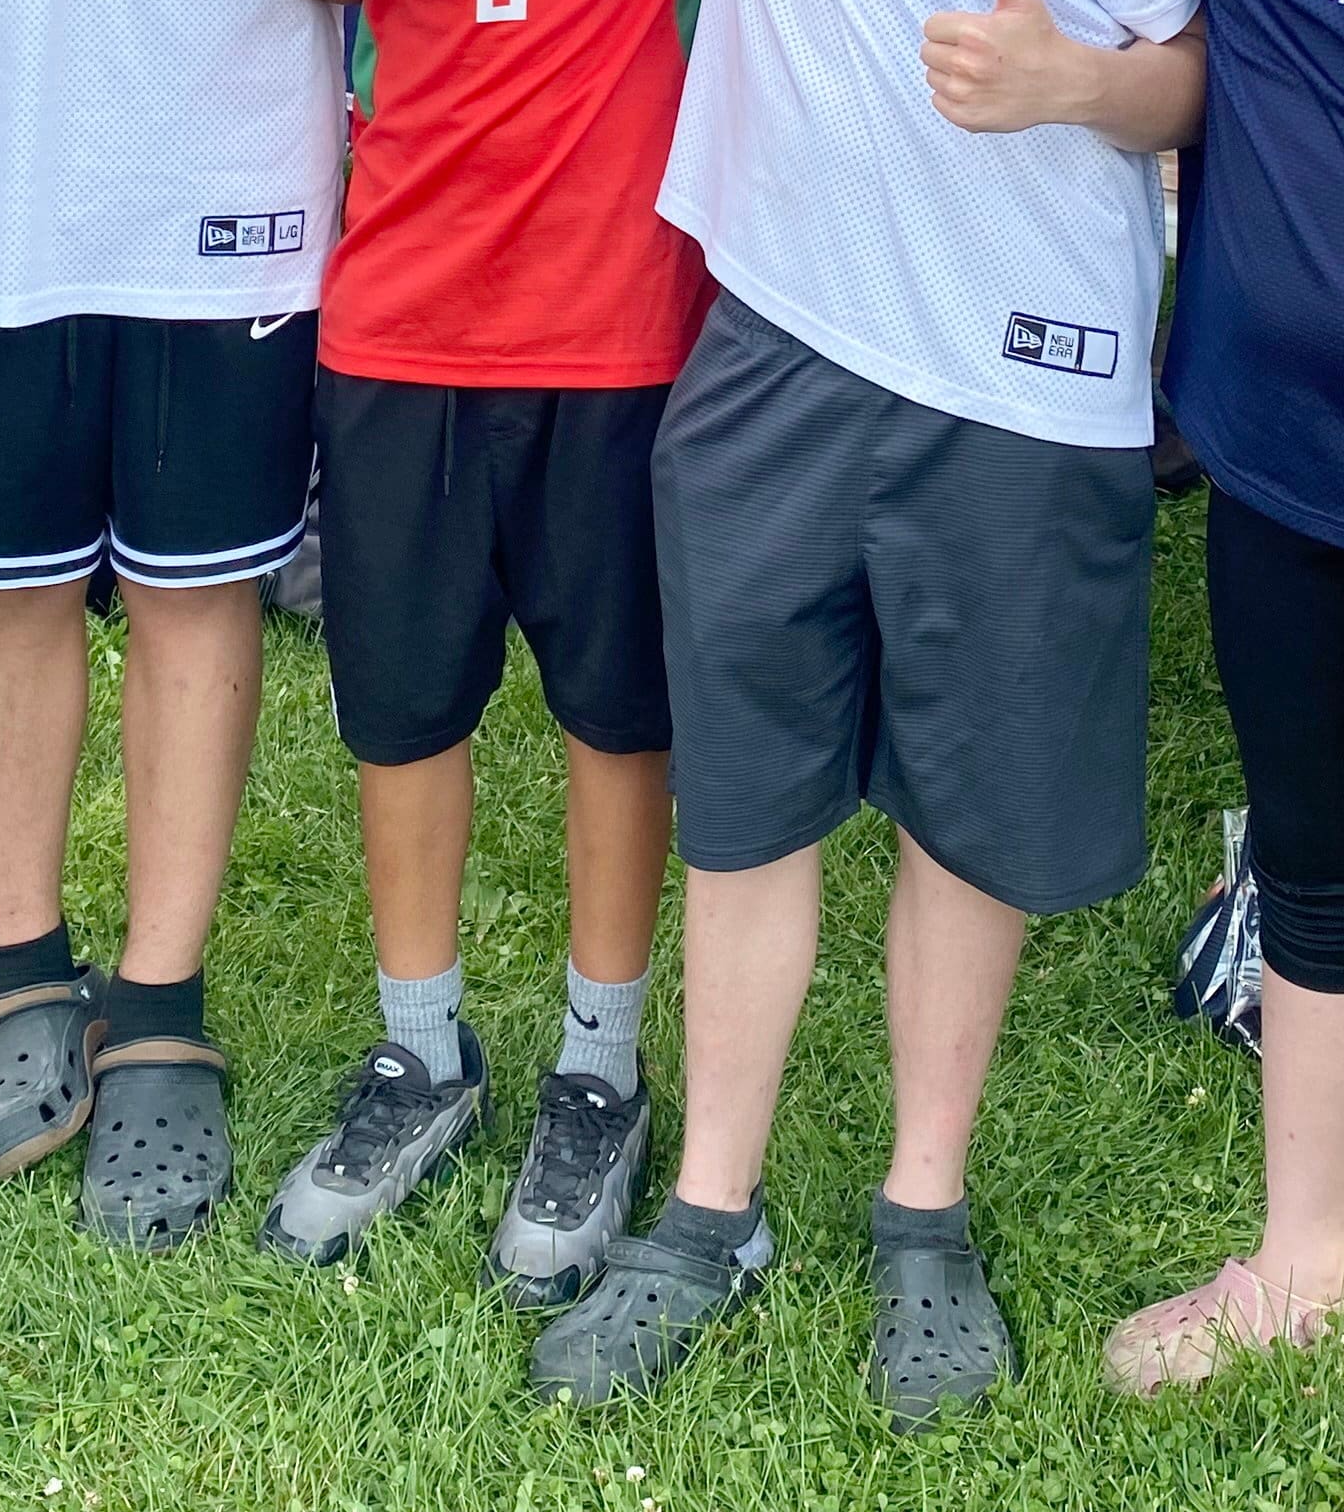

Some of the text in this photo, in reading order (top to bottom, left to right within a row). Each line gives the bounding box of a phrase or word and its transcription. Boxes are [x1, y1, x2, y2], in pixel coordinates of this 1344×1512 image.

[242, 225, 265, 235] NEW
[279, 224, 298, 240] L/G
[242, 235, 265, 247] ERA
[1050, 334, 1075, 347] NEW
[1049, 346, 1074, 359] ERA
